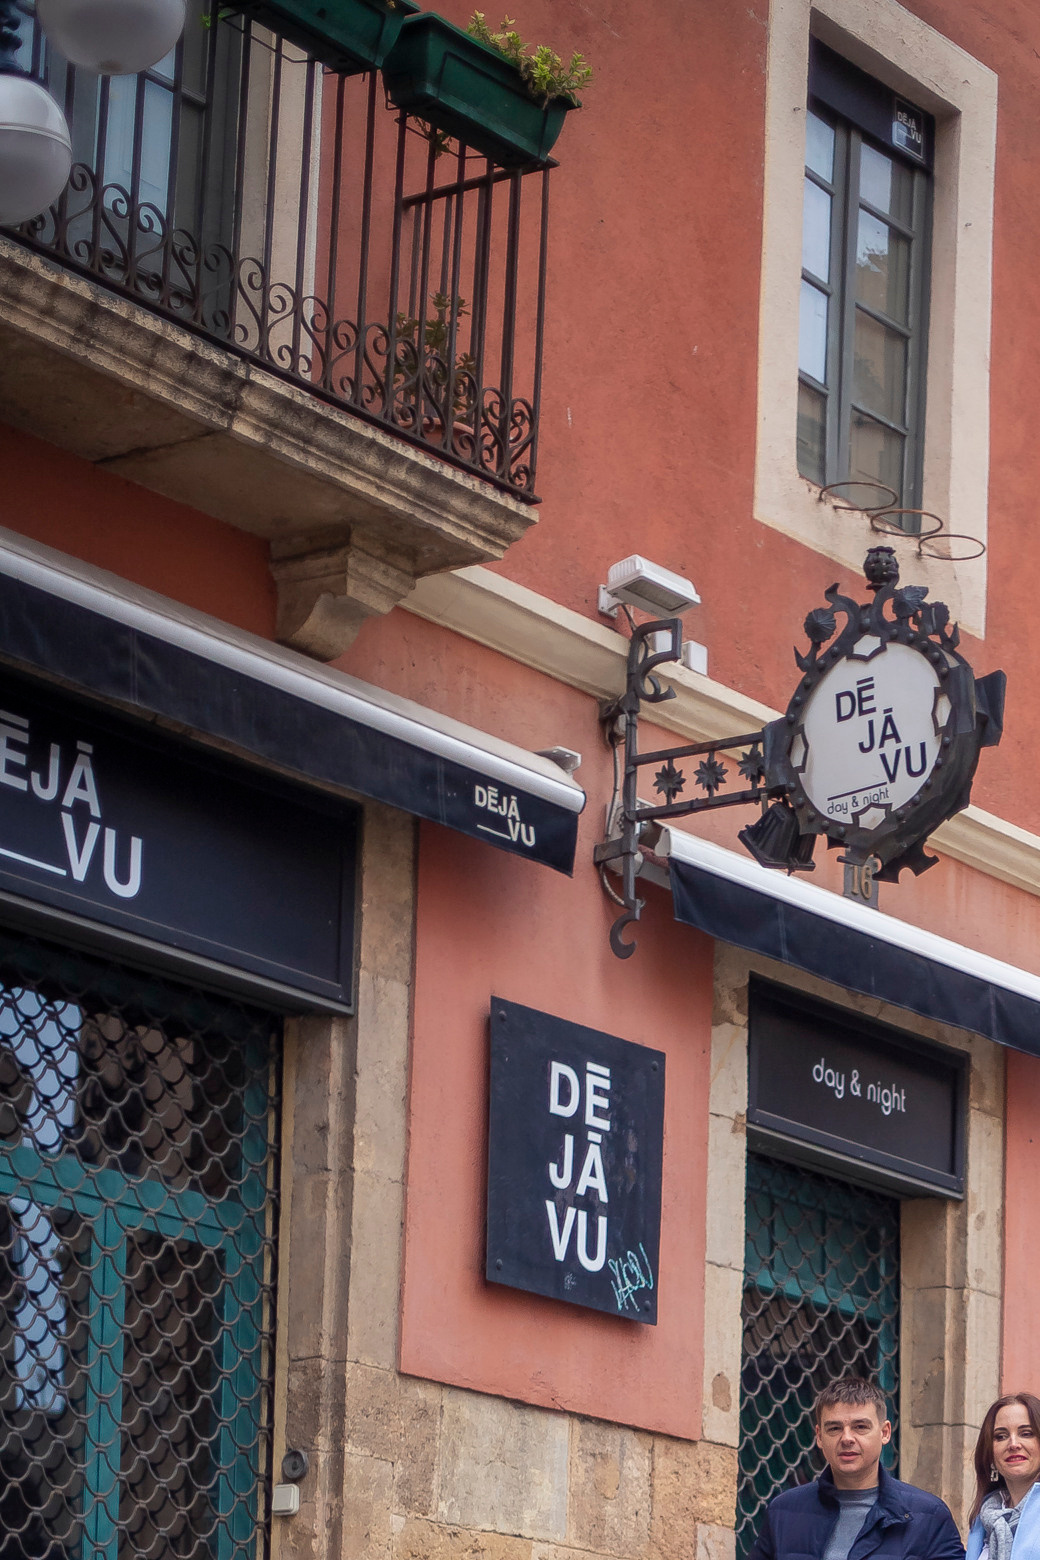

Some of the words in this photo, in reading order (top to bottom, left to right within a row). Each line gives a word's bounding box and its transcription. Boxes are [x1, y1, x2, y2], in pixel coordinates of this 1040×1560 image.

[879, 741, 928, 784] VU
[827, 801, 849, 815] day
[851, 795, 860, 808] &
[862, 787, 889, 803] night
[507, 818, 536, 847] VU
[61, 812, 143, 898] VU
[851, 865, 873, 899] 16
[812, 1057, 845, 1099] day
[850, 1069, 862, 1097] &
[867, 1081, 906, 1116] night
[545, 1199, 608, 1272] VU
